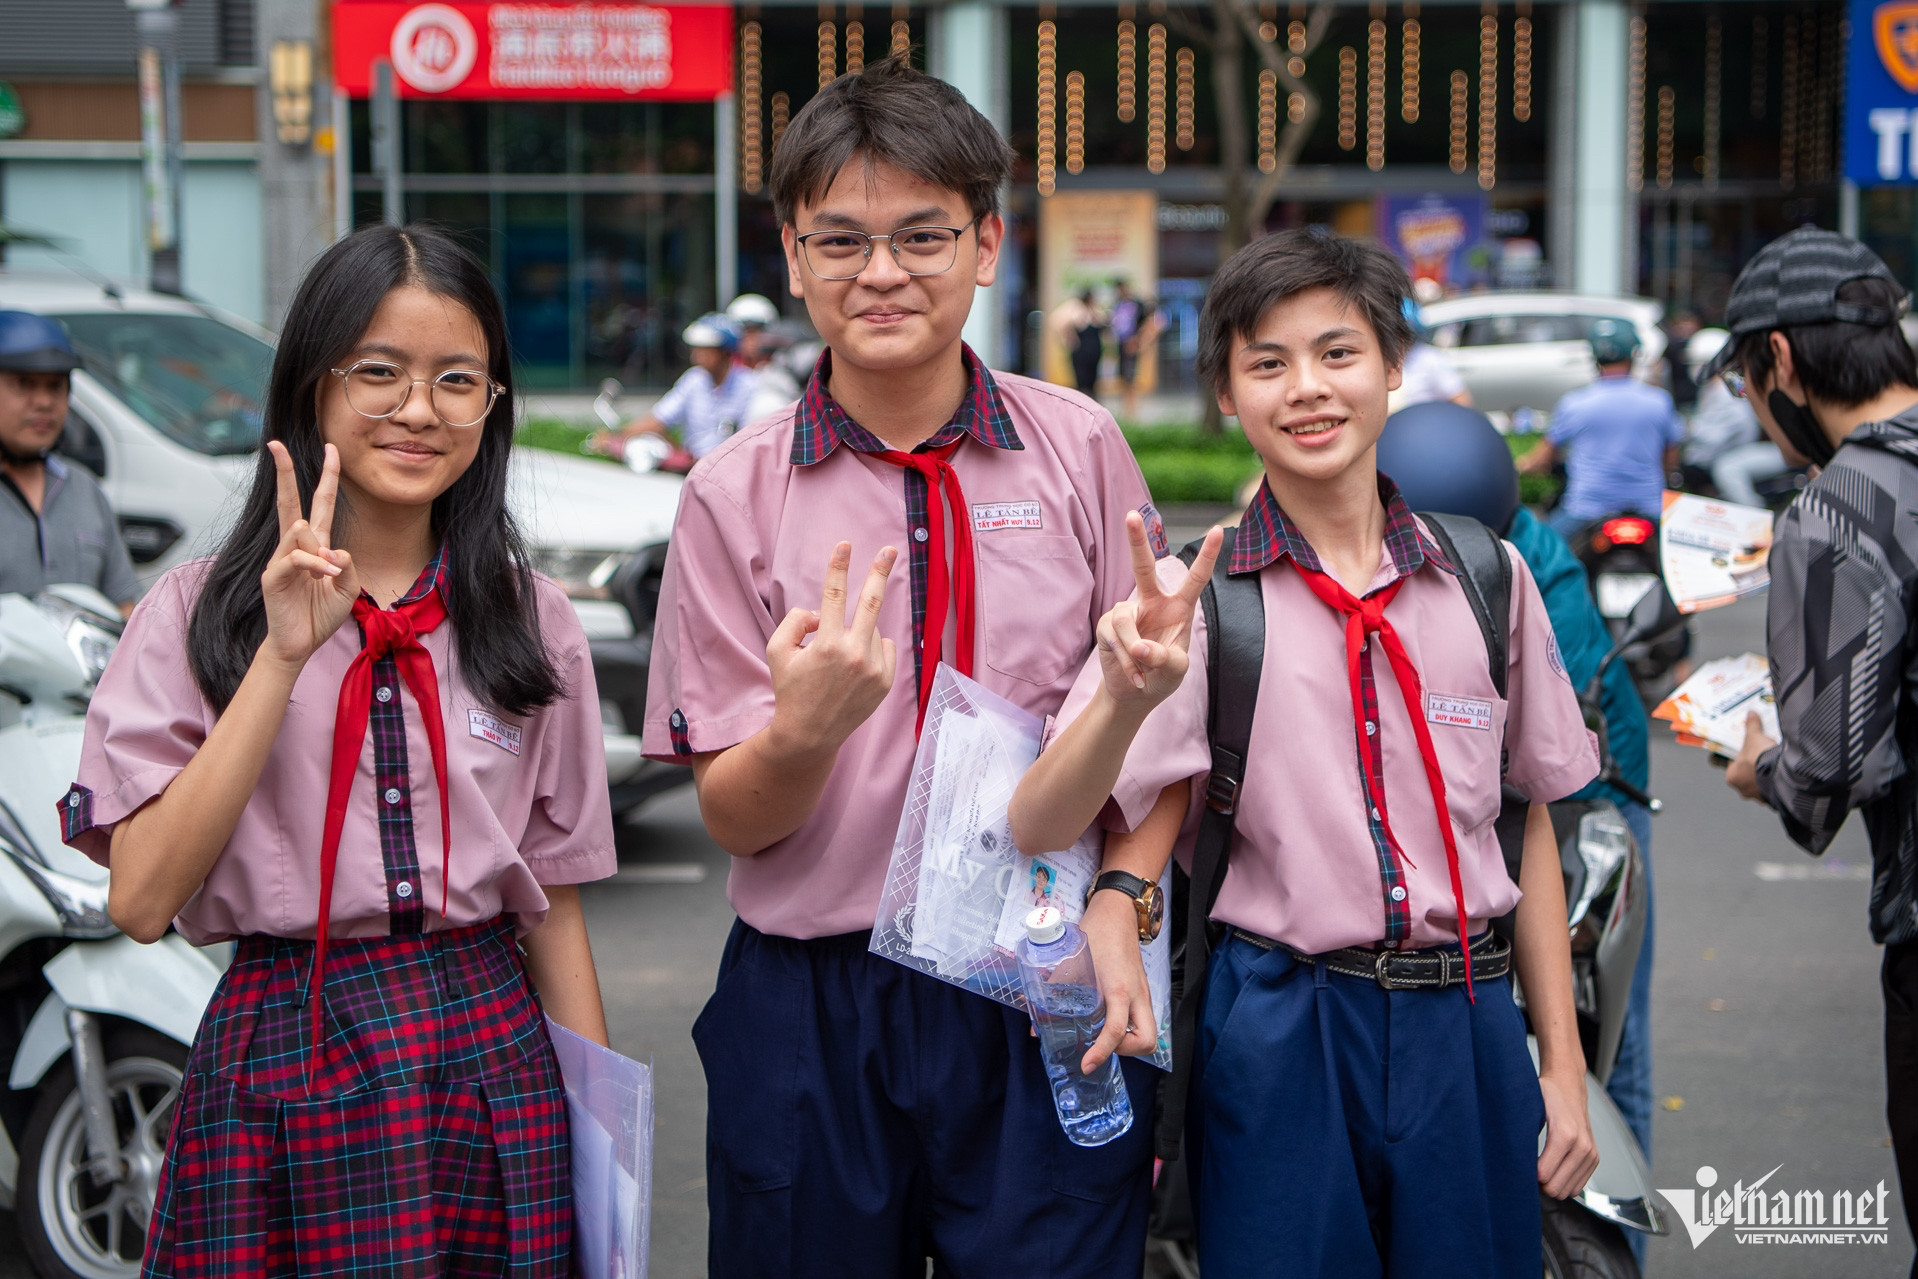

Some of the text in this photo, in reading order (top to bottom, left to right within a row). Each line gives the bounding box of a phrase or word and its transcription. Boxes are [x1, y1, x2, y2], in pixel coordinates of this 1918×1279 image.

[976, 509, 993, 518] LÊ
[1023, 507, 1038, 516] BÊ
[1432, 701, 1447, 711] LÊ
[1435, 713, 1471, 725] DUY KHANG
